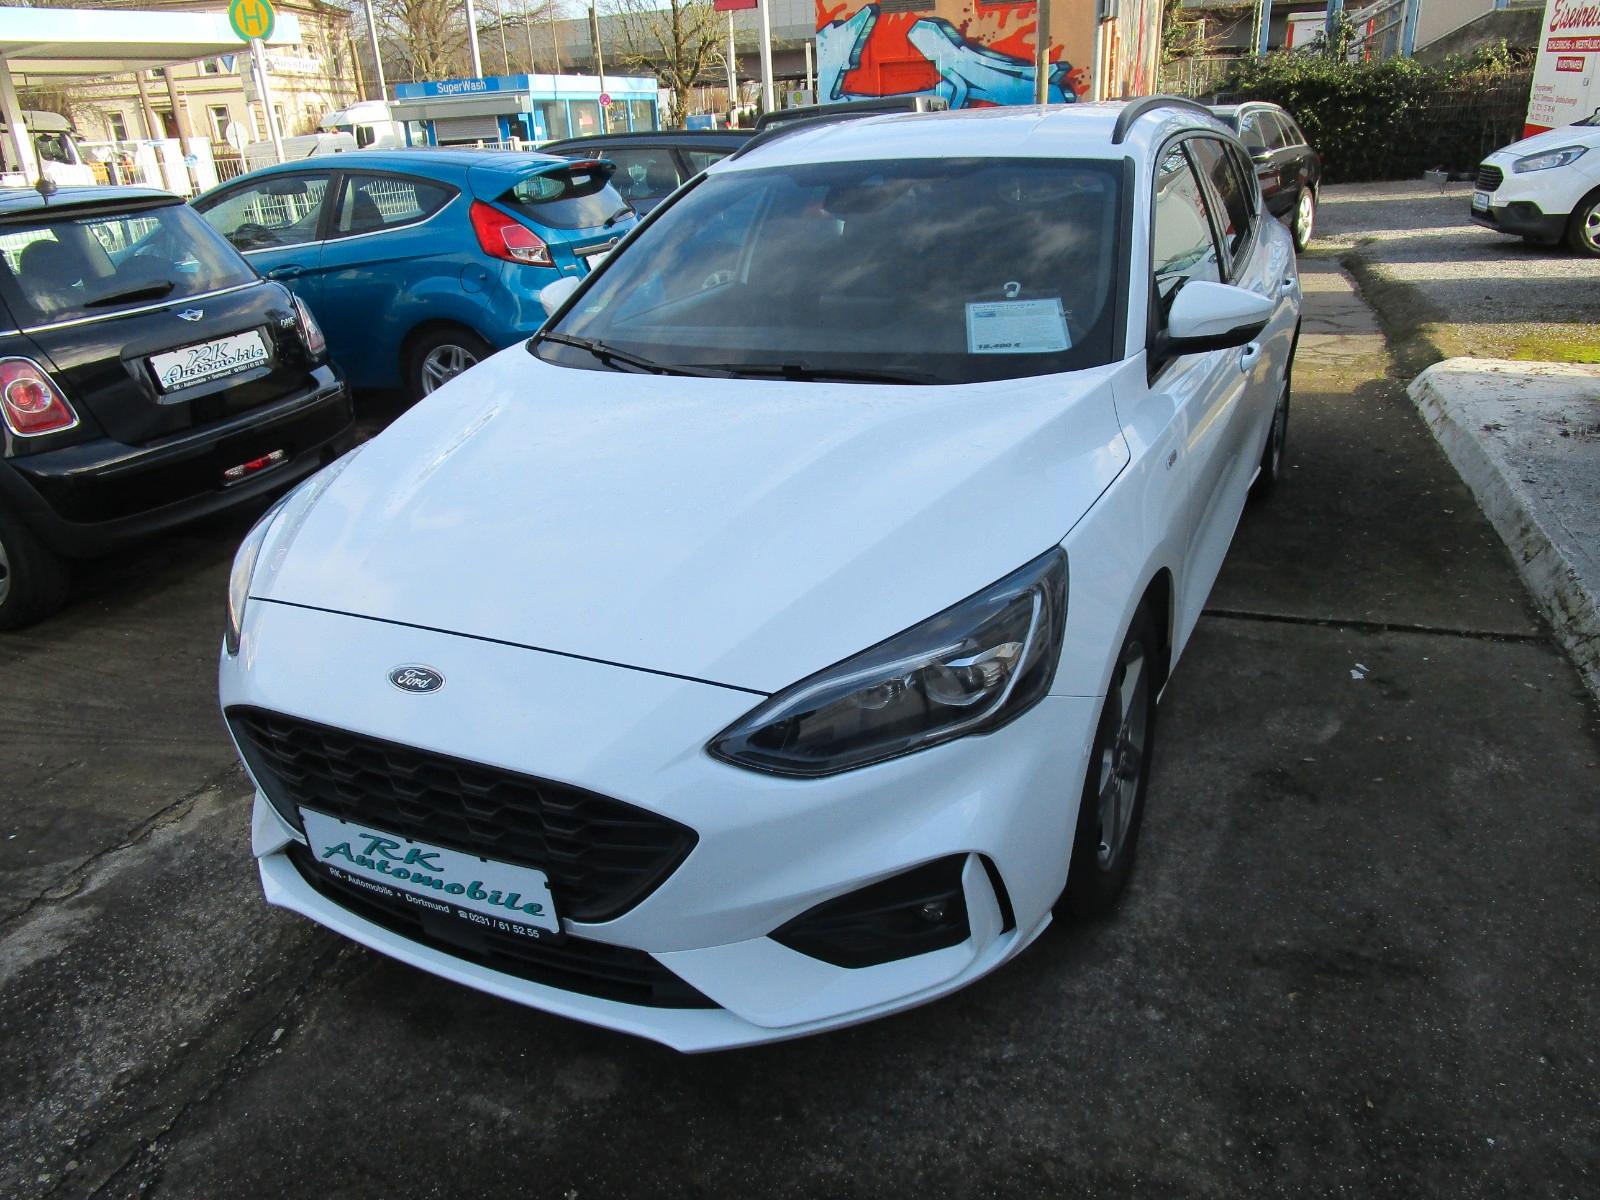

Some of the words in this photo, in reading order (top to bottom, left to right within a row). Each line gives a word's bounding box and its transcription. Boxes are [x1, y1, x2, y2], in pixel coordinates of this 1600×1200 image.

[241, 2, 263, 32] H
[437, 80, 487, 95] SuperWash
[162, 345, 264, 384] Automobile
[397, 669, 433, 688] Ford
[358, 832, 445, 873] RK
[321, 841, 546, 917] Automobile
[328, 867, 343, 880] RK
[347, 874, 394, 897] Automobile
[405, 893, 450, 914] Dortmund
[468, 912, 490, 927] 0231
[498, 921, 510, 932] 61
[512, 924, 525, 936] 52
[526, 927, 540, 939] 55
